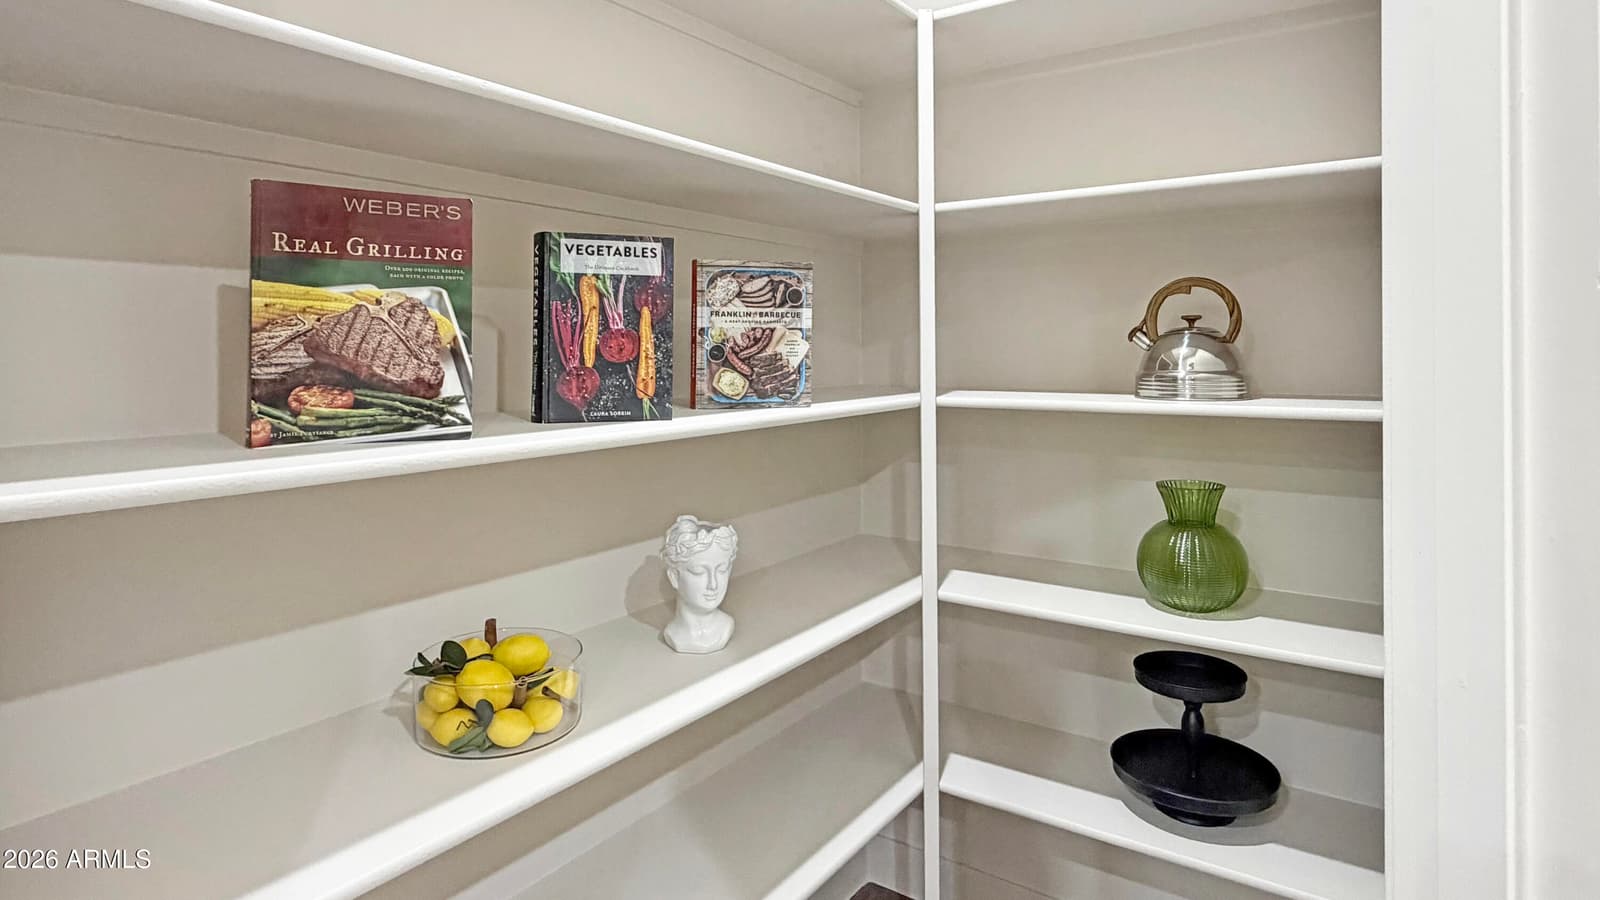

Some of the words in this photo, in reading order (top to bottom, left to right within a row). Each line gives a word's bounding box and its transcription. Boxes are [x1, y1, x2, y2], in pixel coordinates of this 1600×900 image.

[343, 196, 462, 220] WEBER'S
[272, 232, 338, 255] REAL
[346, 237, 463, 261] GRILLING
[564, 243, 658, 259] VEGETABLES
[710, 310, 752, 318] FRANKLIN
[758, 311, 801, 319] BARBECUE
